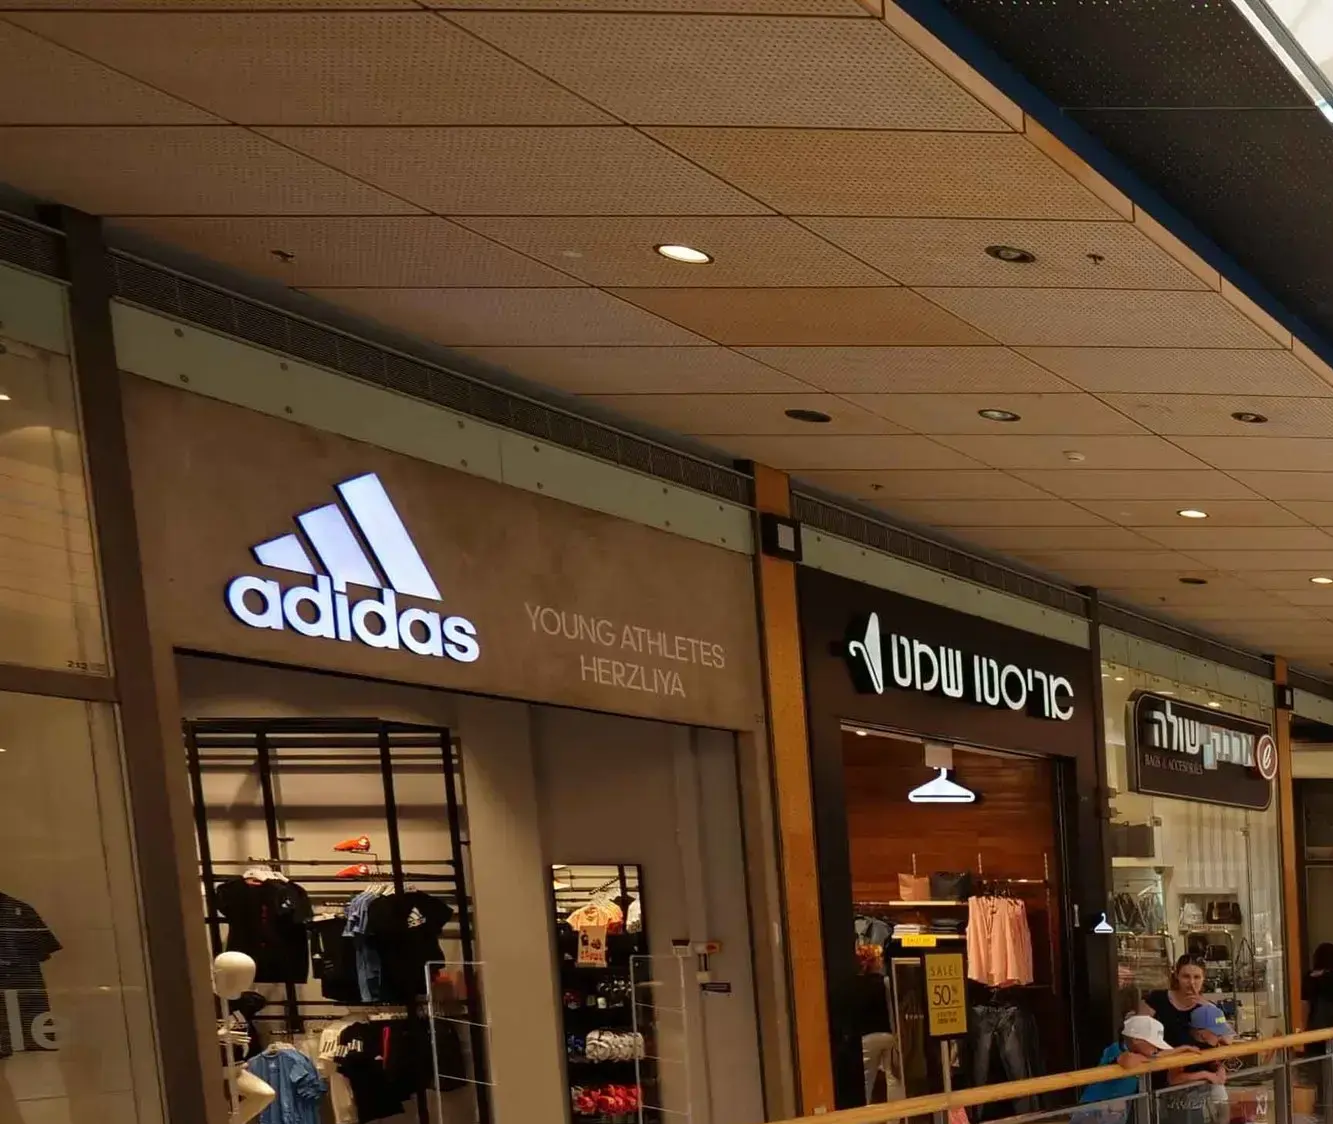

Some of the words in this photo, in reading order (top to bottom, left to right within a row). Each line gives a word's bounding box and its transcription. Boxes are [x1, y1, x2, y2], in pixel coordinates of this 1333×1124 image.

[226, 570, 480, 664] adidas
[525, 602, 618, 649] YOUNG
[618, 618, 726, 671] ATHLETES
[579, 653, 686, 699] HERZLIYA
[891, 633, 964, 699] שמט
[974, 654, 1074, 721] אריסטו
[1152, 700, 1201, 755] שולה
